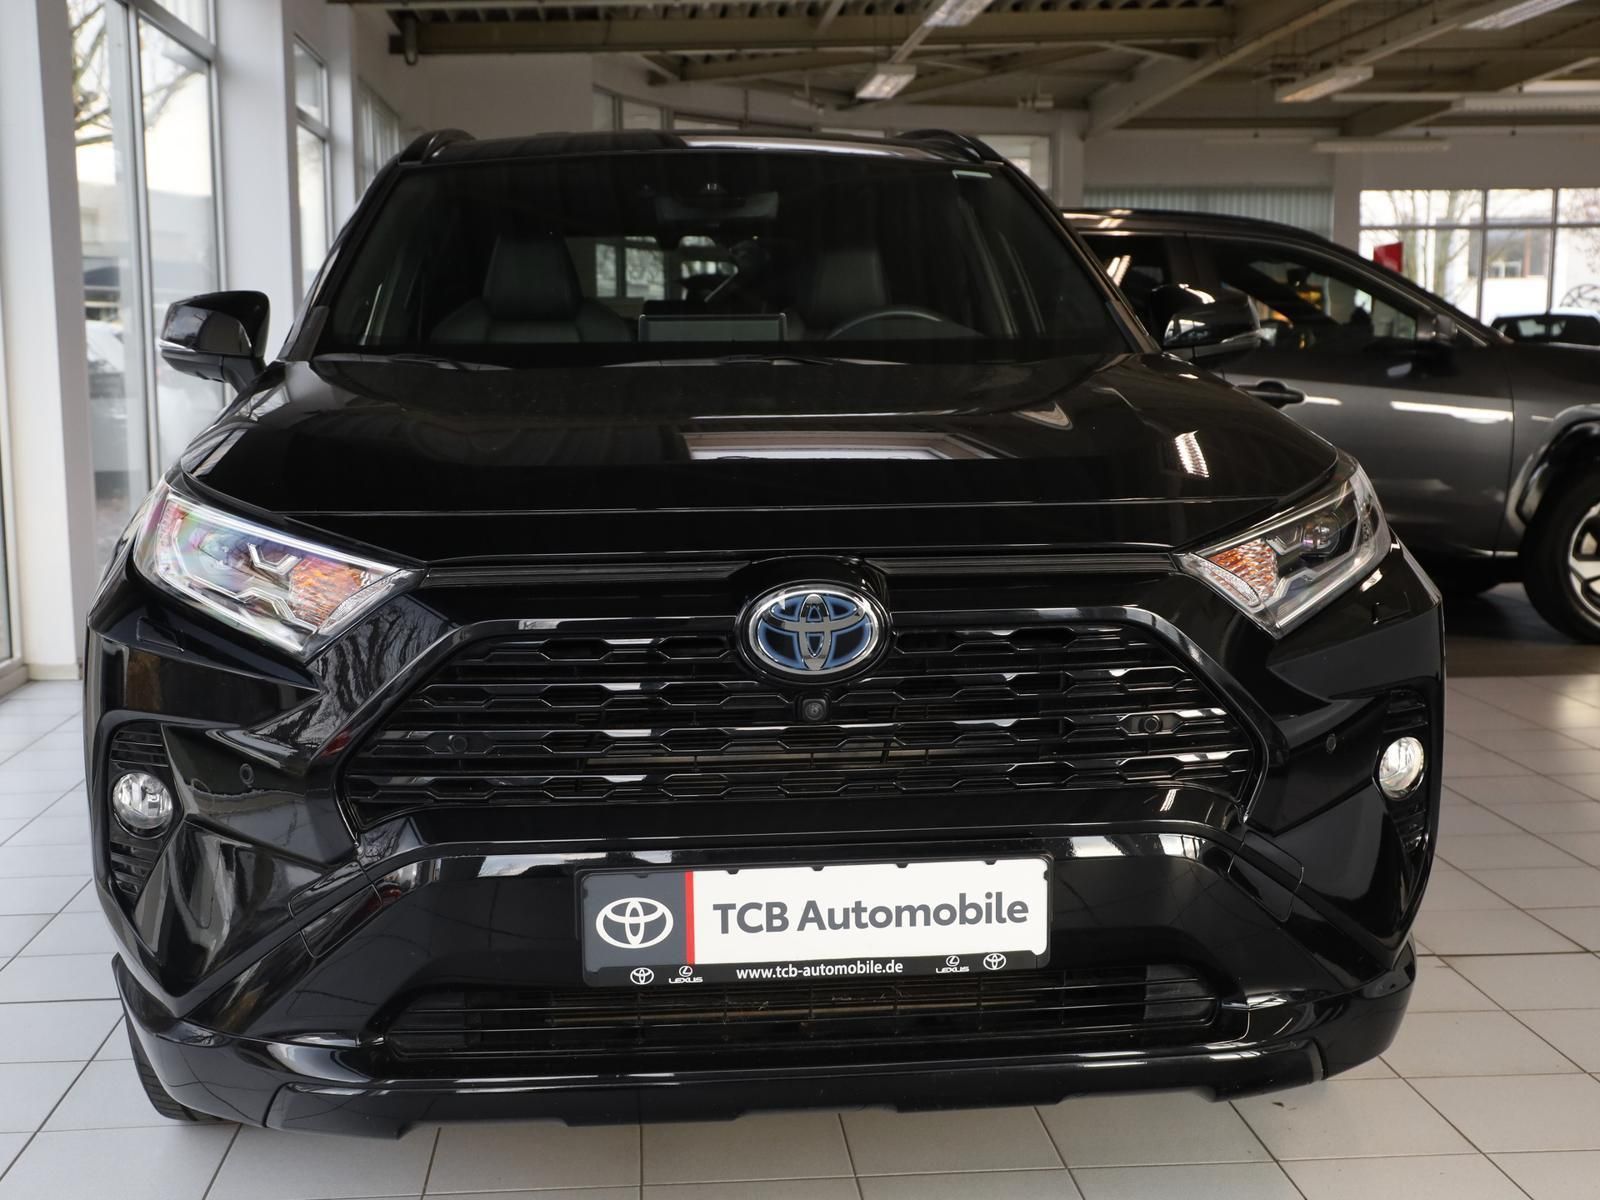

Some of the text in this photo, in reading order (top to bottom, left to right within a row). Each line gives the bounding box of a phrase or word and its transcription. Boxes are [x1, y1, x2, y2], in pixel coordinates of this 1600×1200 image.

[713, 892, 1028, 934] TCB Automobile
[736, 962, 904, 980] www.tcb-automobile.de
[935, 966, 970, 974] LEXUS
